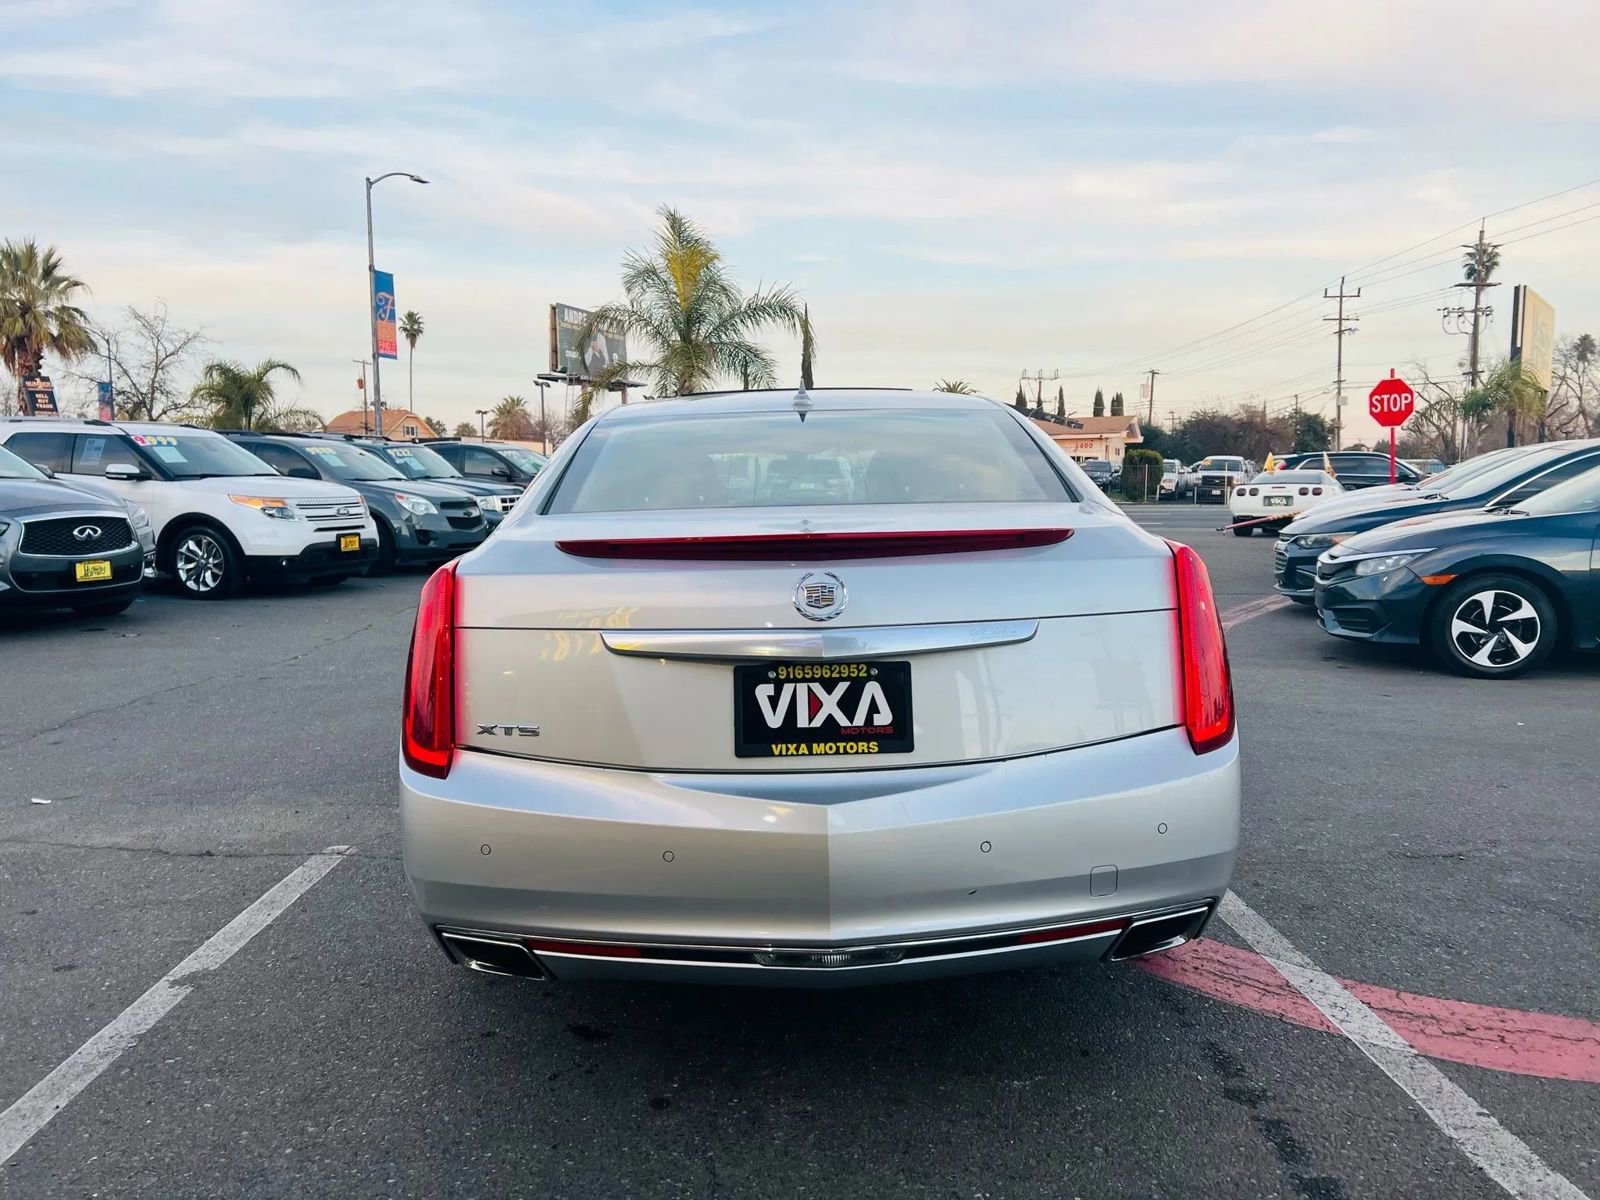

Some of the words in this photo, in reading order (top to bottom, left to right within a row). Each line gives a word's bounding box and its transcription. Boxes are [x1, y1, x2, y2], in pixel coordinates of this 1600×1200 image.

[1371, 393, 1412, 413] STOP
[778, 663, 867, 679] 9165962952
[754, 680, 893, 728] VIXA
[476, 723, 540, 737] XTS
[841, 726, 894, 734] MOTORS
[772, 743, 809, 756] VIXA
[812, 741, 879, 755] MOTORS
